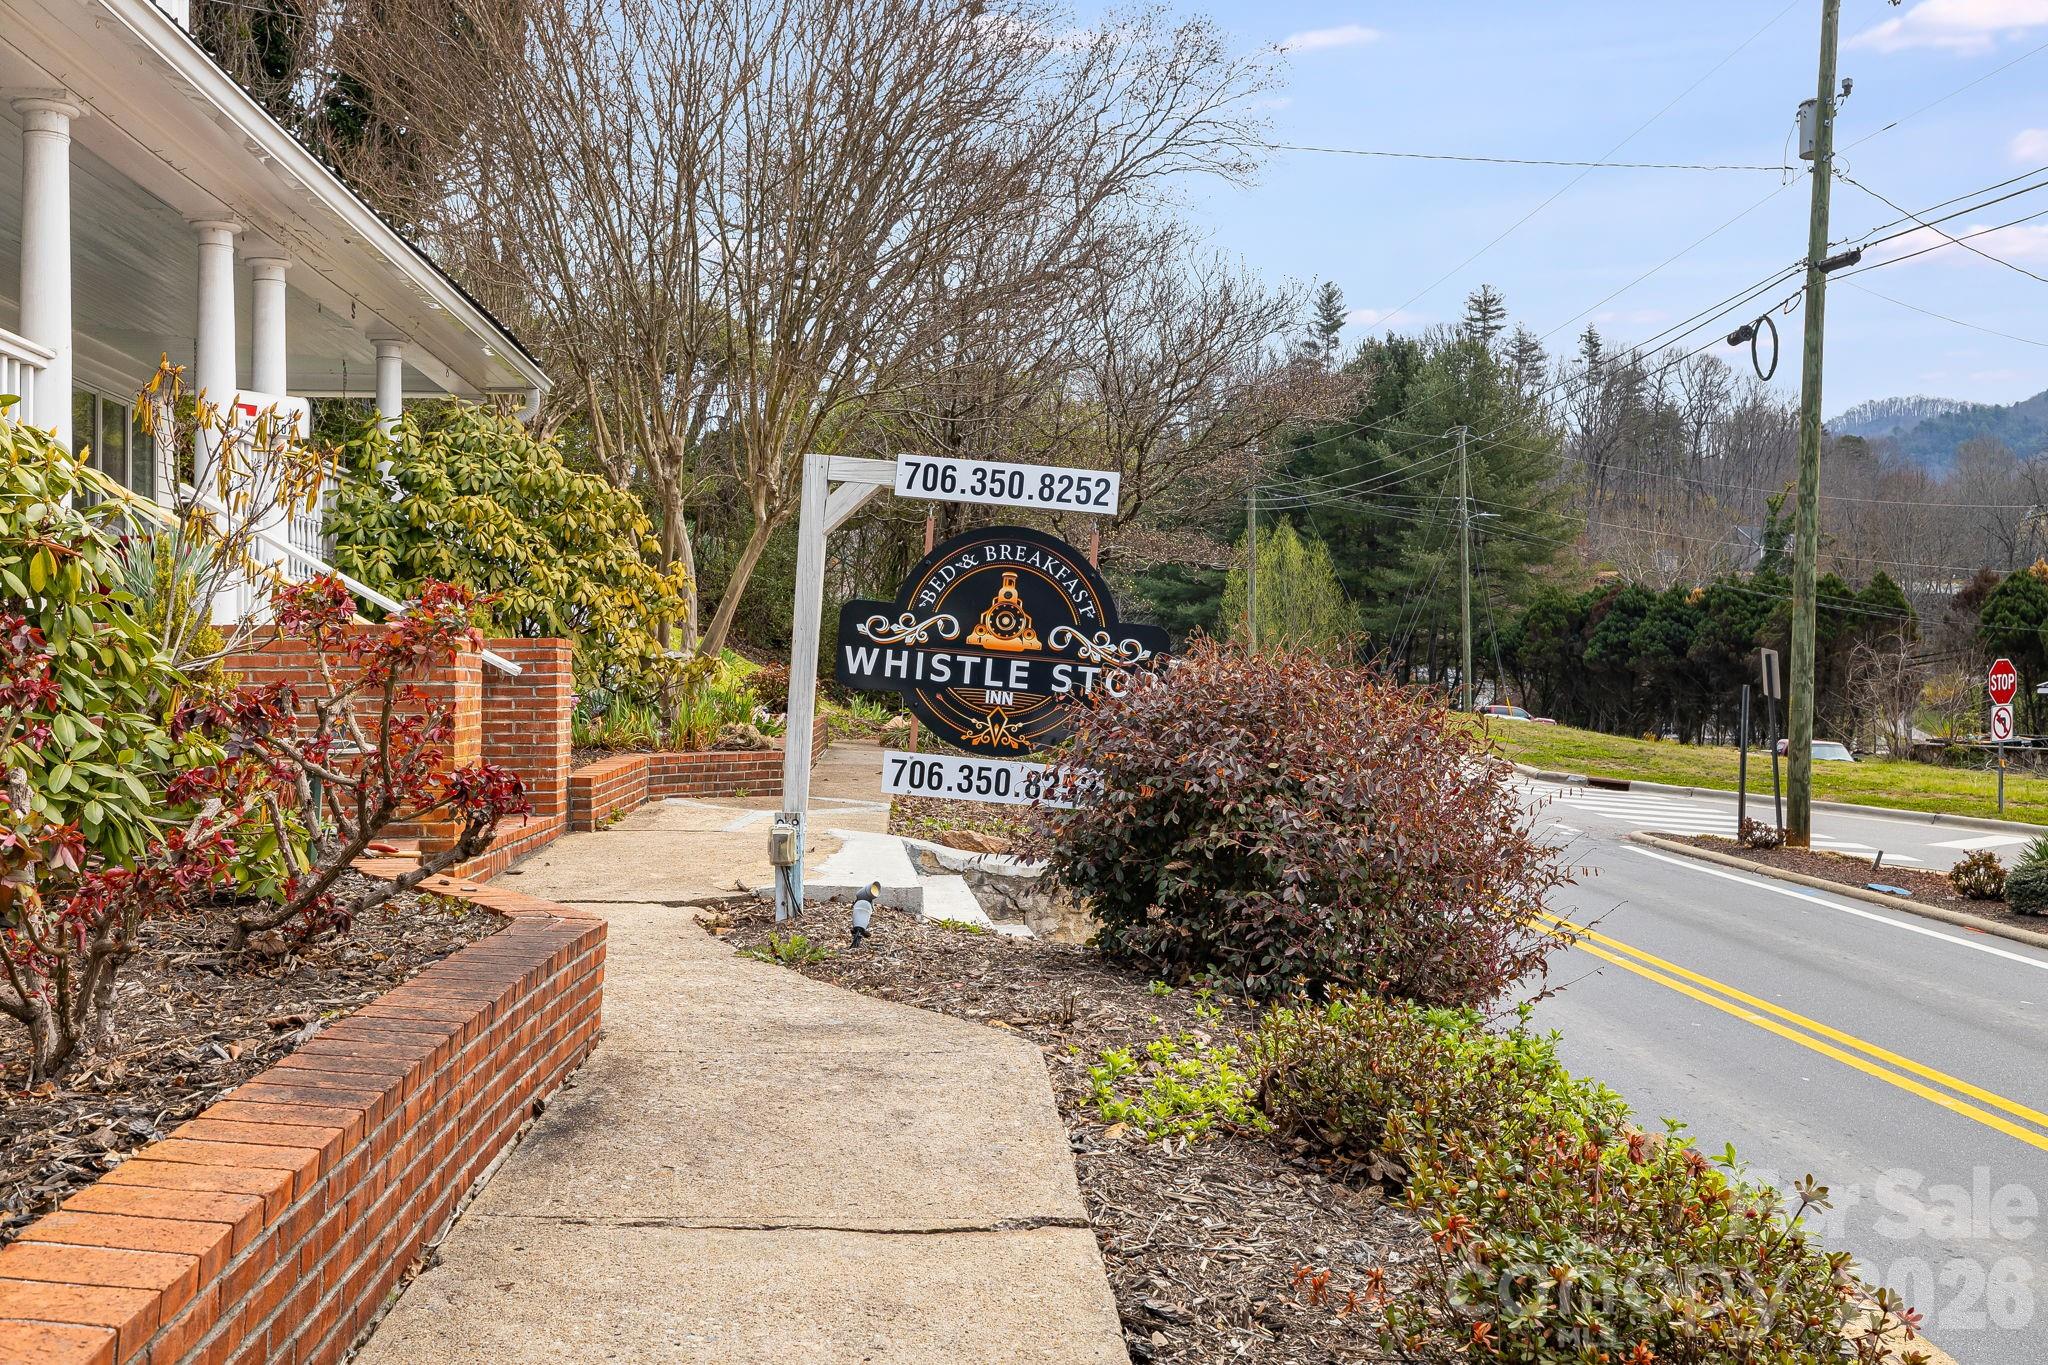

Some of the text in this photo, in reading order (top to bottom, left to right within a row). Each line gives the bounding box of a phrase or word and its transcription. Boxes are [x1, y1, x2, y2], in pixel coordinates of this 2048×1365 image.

[904, 461, 1112, 507] 706.350.8252
[920, 544, 1096, 619] BED & BREAKFAST
[845, 645, 1031, 690] WHISTLE
[1991, 674, 2014, 691] STOP
[985, 689, 1014, 706] INN
